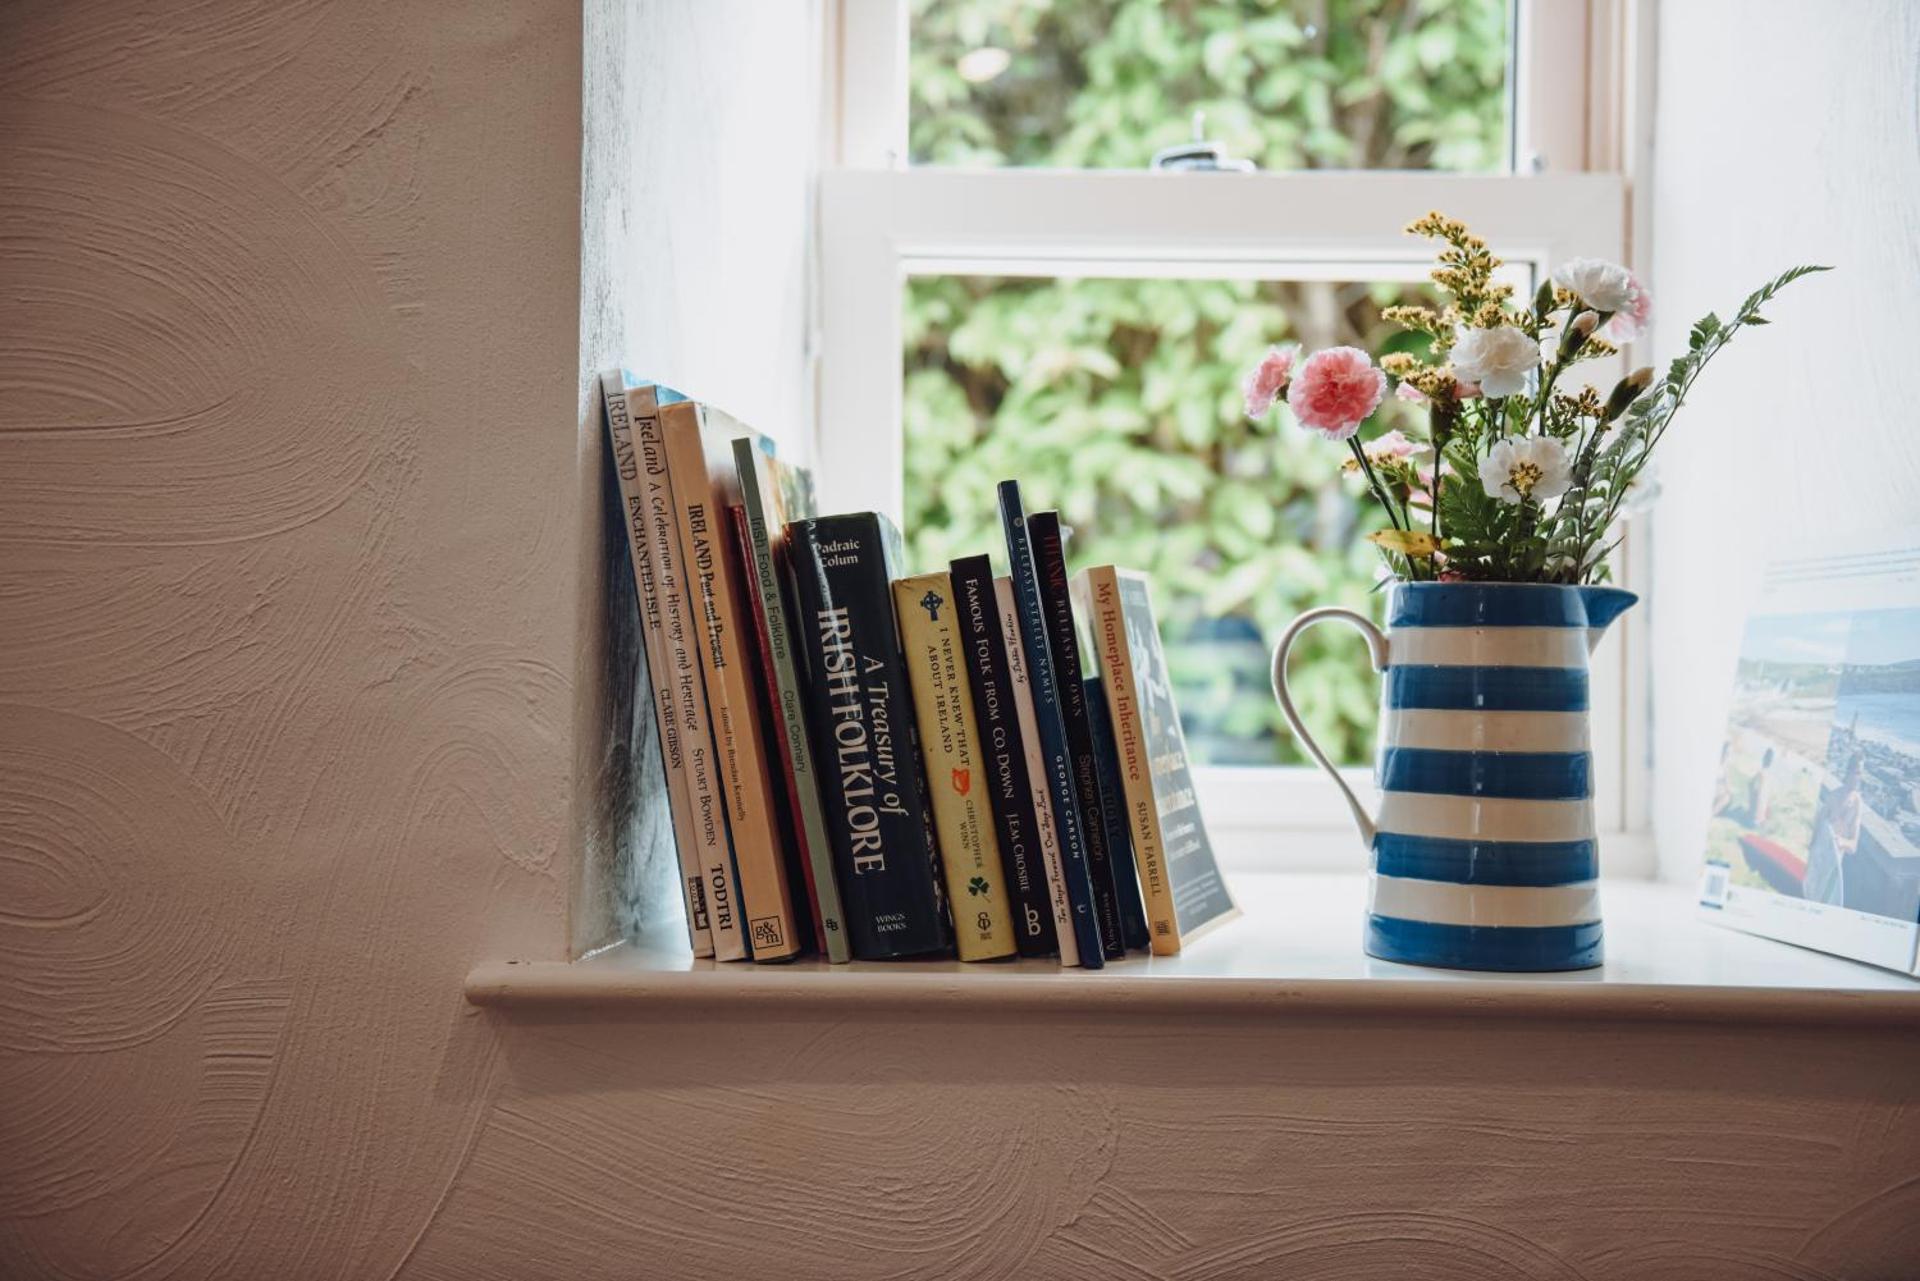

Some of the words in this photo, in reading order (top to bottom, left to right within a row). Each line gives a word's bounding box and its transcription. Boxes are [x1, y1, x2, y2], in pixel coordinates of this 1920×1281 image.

[607, 392, 636, 481] IRELAND
[629, 496, 655, 592] ENCHANTED
[645, 600, 660, 632] ISLE
[634, 415, 664, 476] Ireland
[649, 483, 661, 493] A
[664, 576, 676, 588] of
[676, 648, 688, 671] and
[688, 504, 711, 571] IRELAND
[752, 518, 768, 548] Irish
[812, 539, 861, 554] Padraic
[758, 553, 773, 587] Food
[820, 554, 858, 567] Colum
[699, 573, 715, 597] Past
[765, 593, 774, 602] &
[1097, 583, 1110, 605] My
[703, 600, 719, 621] and
[964, 579, 984, 632] FAMOUS
[1018, 539, 1035, 593] BELFAST
[1030, 602, 1045, 650] STREET
[1039, 659, 1054, 704] NAMES
[709, 624, 726, 669] Present
[767, 607, 785, 660] Folklore
[817, 607, 859, 696] IRISH
[1102, 610, 1124, 692] Homeplace
[863, 655, 884, 674] A
[942, 639, 956, 681] NEVER
[976, 639, 991, 676] FOLK
[660, 689, 673, 725] CLARE
[783, 690, 795, 720] Clare
[927, 646, 943, 690] ABOUT
[936, 693, 952, 754] IRELAND
[949, 685, 964, 727] KNEW
[983, 681, 1000, 720] FROM
[720, 706, 732, 734] Edited
[867, 681, 897, 785] Treasury
[1117, 695, 1139, 781] Inheritance
[666, 729, 681, 768] GIBSON
[956, 729, 970, 766] THAT
[831, 703, 886, 875] FOLKLORE
[998, 753, 1014, 798] DOWN
[879, 792, 909, 816] of
[1056, 756, 1069, 803] GEORGE
[1065, 810, 1080, 858] CARSON
[1136, 801, 1151, 840] SUSAN
[959, 822, 970, 850] WINN
[965, 800, 982, 869] CHRISTOPHER
[1143, 846, 1160, 897] FARRELL
[711, 864, 732, 930] TODTRI
[875, 914, 906, 924] WINGS
[877, 922, 907, 933] BOOKS
